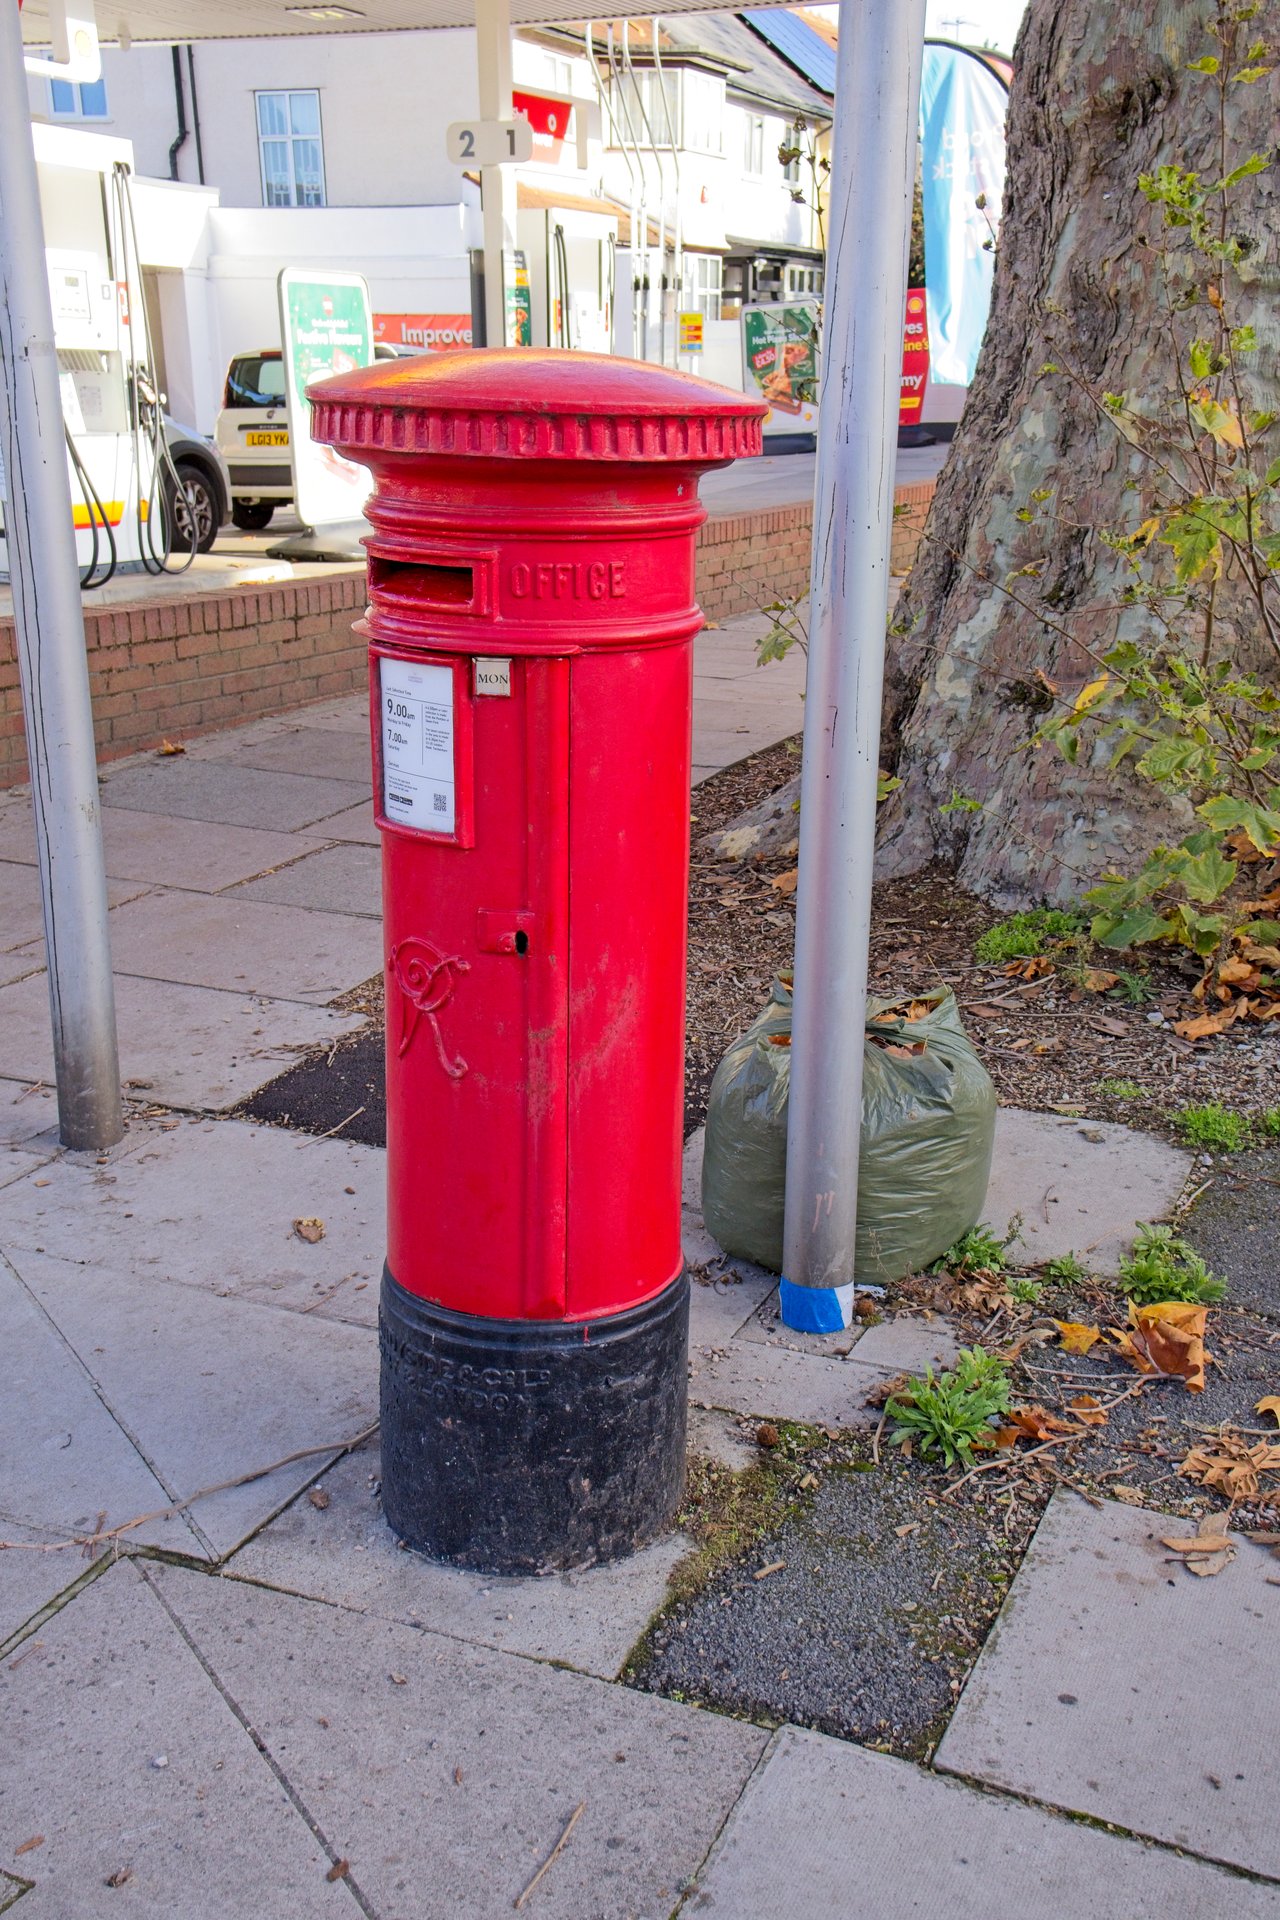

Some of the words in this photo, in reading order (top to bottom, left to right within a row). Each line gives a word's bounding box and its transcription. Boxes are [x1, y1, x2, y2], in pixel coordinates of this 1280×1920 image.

[459, 130, 475, 157] 2
[506, 129, 515, 155] 1
[401, 322, 472, 348] Improve
[511, 561, 626, 600] OFFICE
[478, 673, 508, 684] MON
